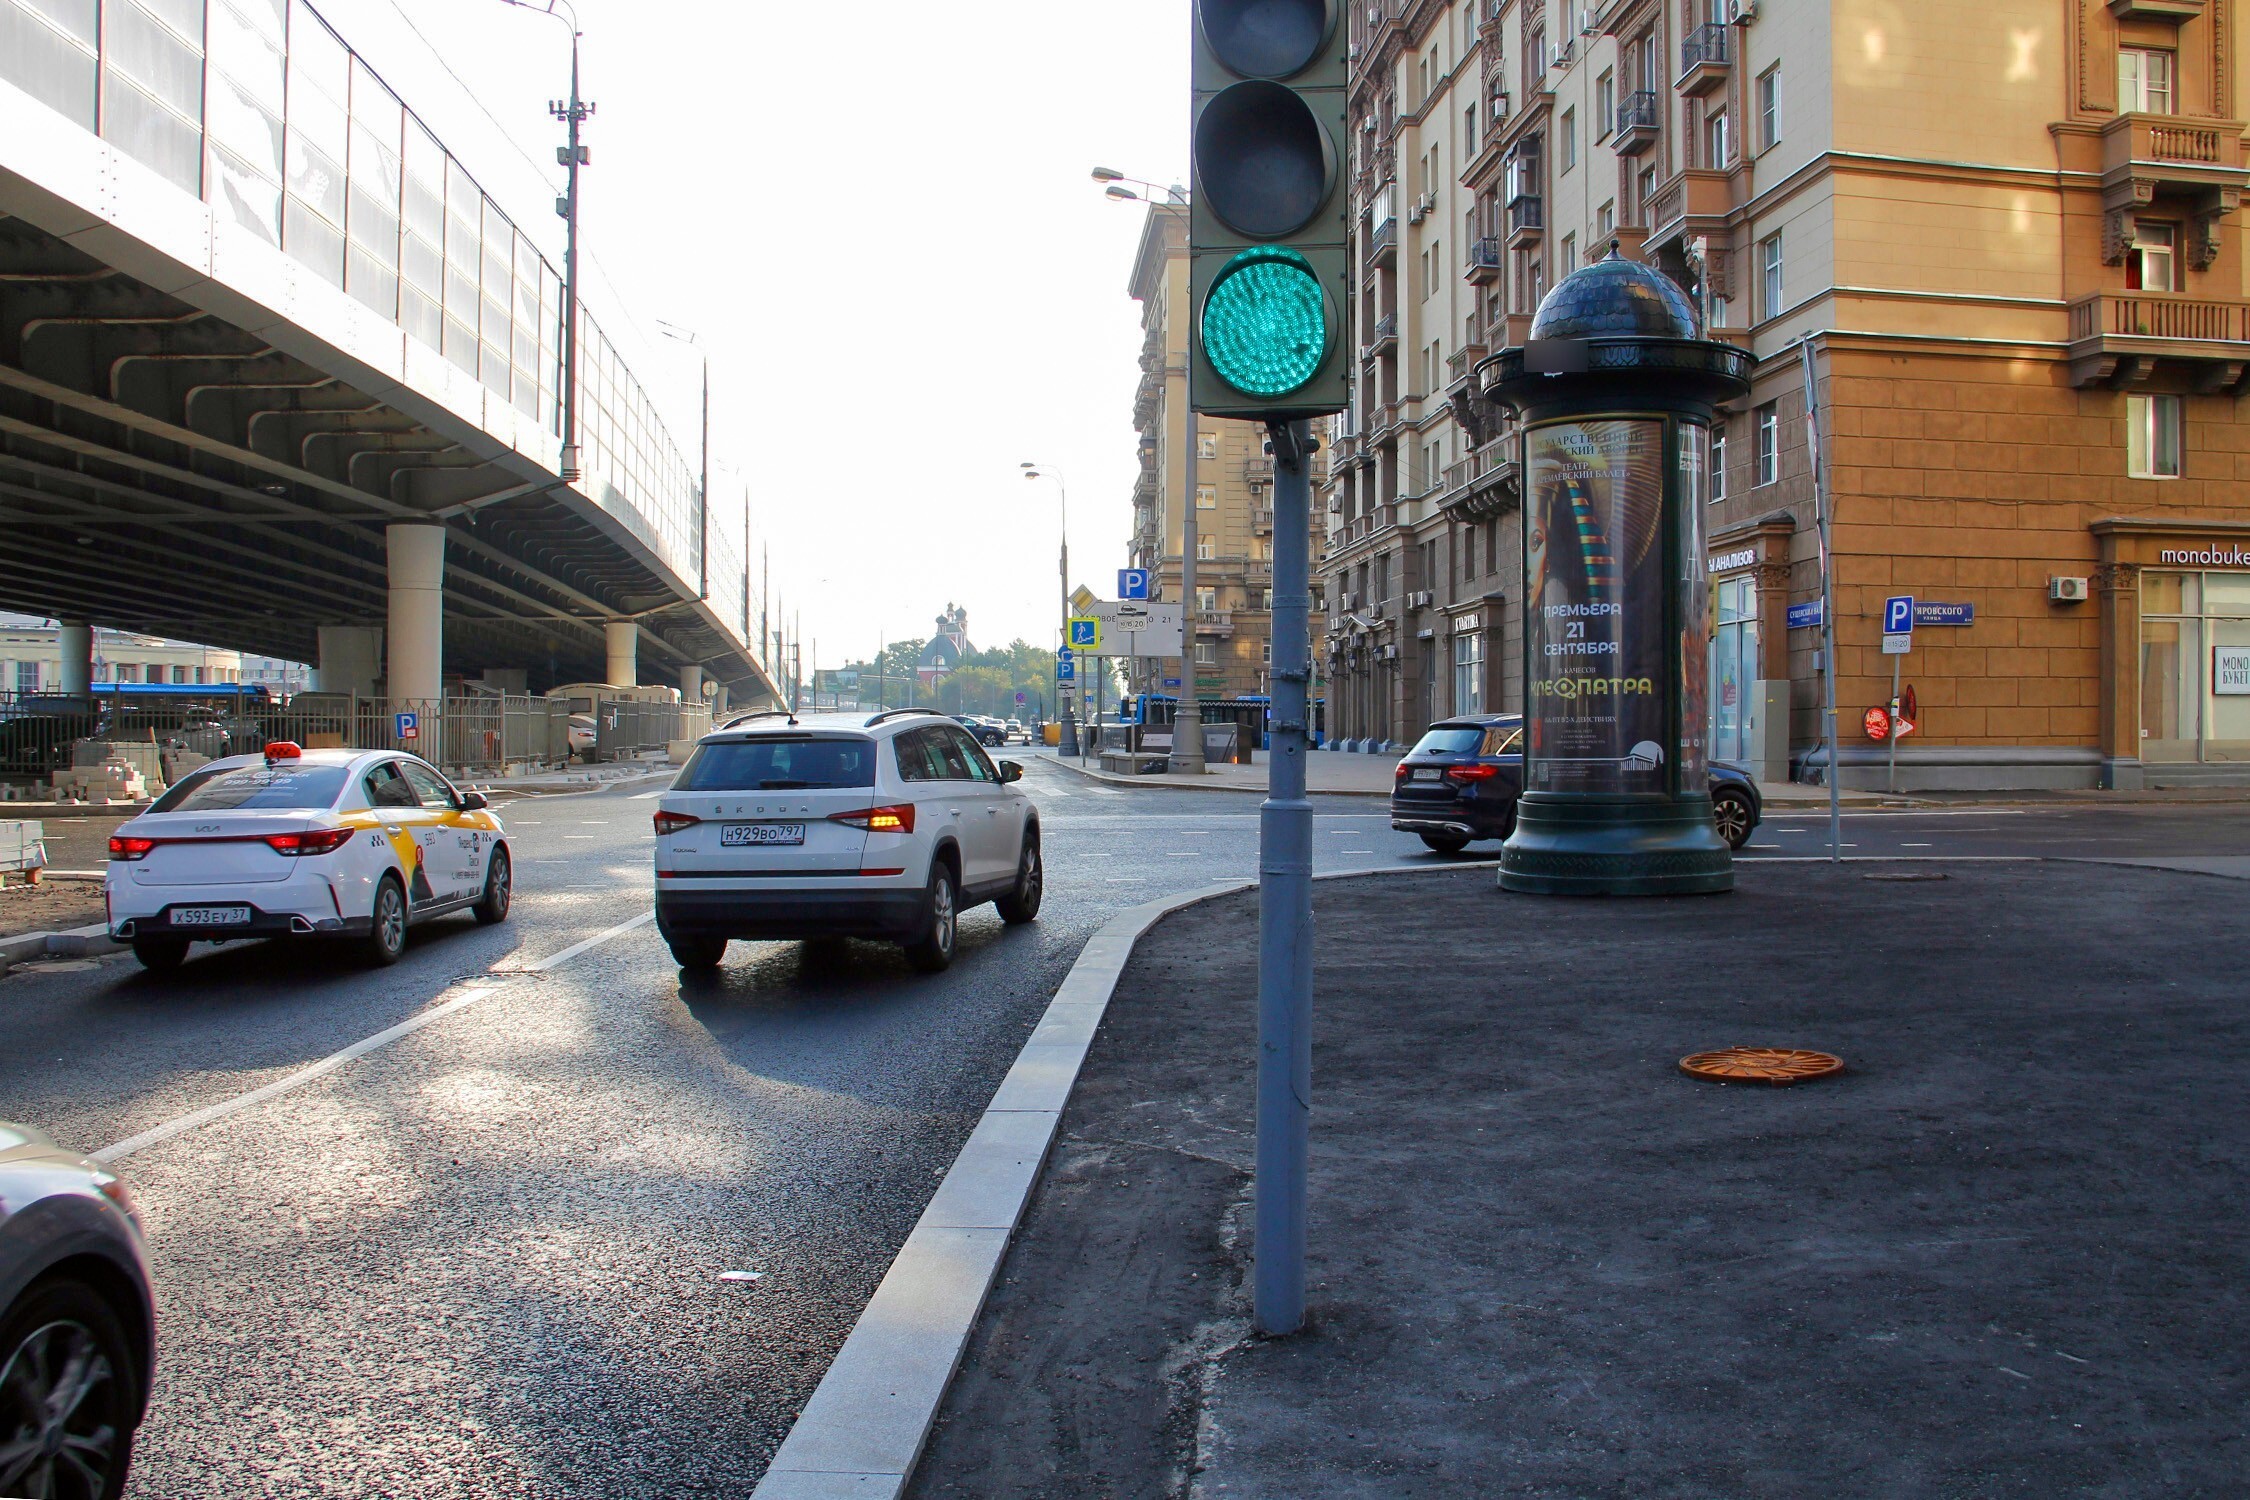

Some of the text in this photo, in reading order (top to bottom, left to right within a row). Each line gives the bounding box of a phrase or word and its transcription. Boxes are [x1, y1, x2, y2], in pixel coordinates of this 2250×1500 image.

[1562, 462, 1589, 471] ТЕАТР
[1715, 549, 1754, 571] АНАЛИЗОВ
[1125, 572, 1143, 596] P
[1544, 603, 1622, 618] ПРЕМЬЕРА
[1891, 601, 1908, 630] P
[1566, 621, 1585, 639] 21
[1544, 641, 1619, 656] СЕНТЯБРЯ
[1900, 640, 1908, 648] 20
[2223, 656, 2248, 670] MONO
[2223, 670, 2249, 684] БУКЕТ
[1530, 677, 1653, 699] КЛЕОПАТРА
[726, 825, 801, 841] Н929ВО 797
[176, 908, 245, 924] Х593ЕУ 37
